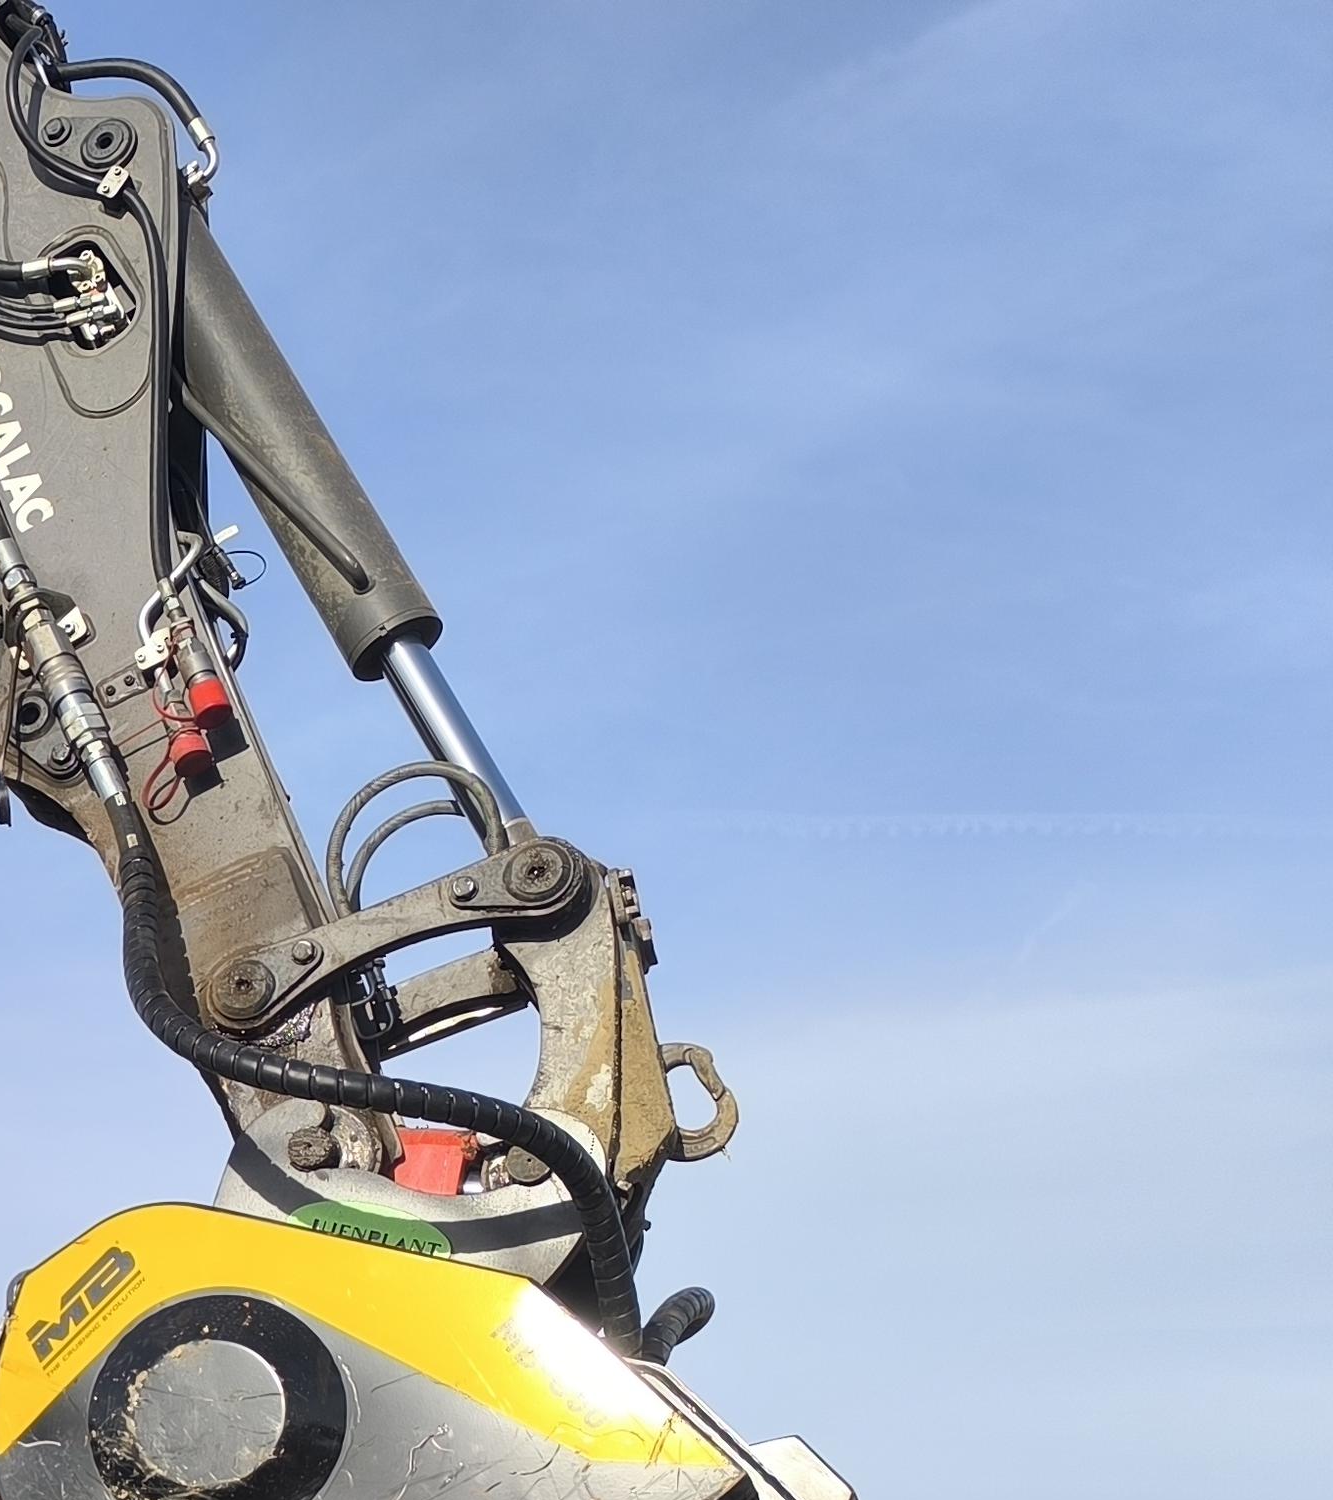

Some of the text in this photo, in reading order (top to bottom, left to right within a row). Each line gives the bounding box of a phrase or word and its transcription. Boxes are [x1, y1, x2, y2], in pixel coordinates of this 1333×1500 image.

[25, 1246, 136, 1364] MB
[46, 1361, 60, 1378] THE
[102, 1275, 147, 1322] EVOLUTION
